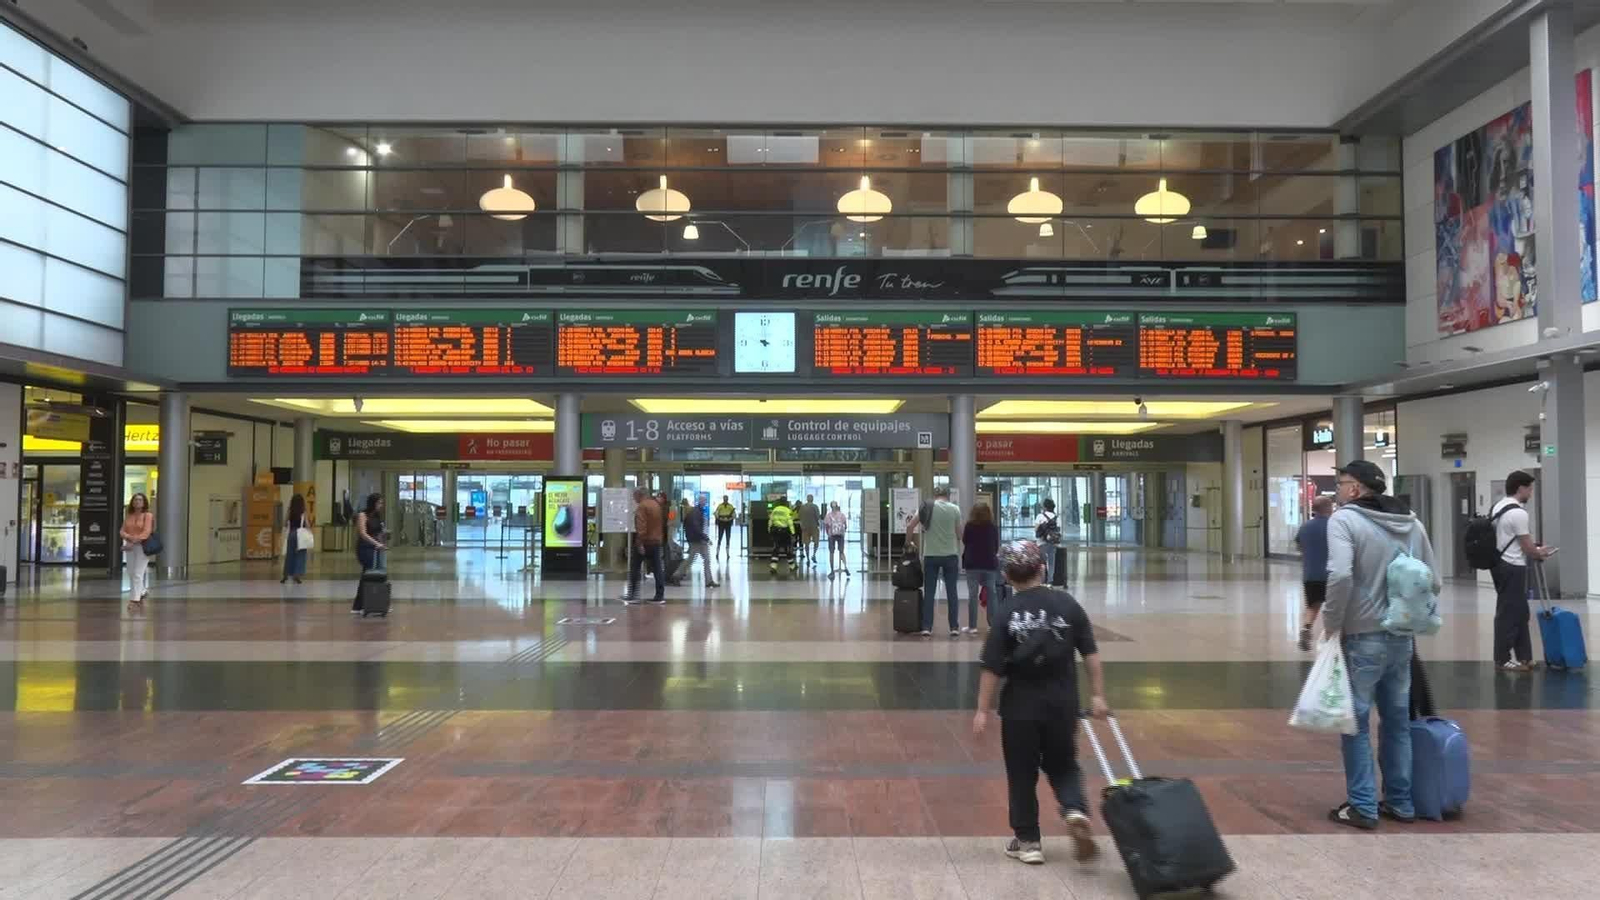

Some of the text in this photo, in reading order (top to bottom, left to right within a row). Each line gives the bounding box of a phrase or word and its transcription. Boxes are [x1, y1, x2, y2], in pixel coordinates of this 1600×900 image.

[630, 272, 656, 283] renfe
[782, 265, 862, 297] renfe
[877, 273, 897, 289] Tu
[232, 312, 264, 321] Llegadas
[396, 313, 428, 321] Llegadas
[559, 313, 592, 321] Llegadas
[815, 314, 841, 322] Salidas
[979, 314, 1005, 322] Salidas
[1141, 315, 1166, 323] Salidas
[666, 418, 744, 431] Acceso a vías
[787, 419, 911, 434] Control de equipajes
[626, 419, 659, 441] 1-8
[666, 433, 712, 441] PLATFORMS
[787, 433, 862, 441] LUGGAGE CONTROL
[348, 437, 391, 449] Llegadas
[486, 438, 530, 449] No pasar
[986, 440, 1014, 450] pasar
[1111, 439, 1154, 450] Llegadas
